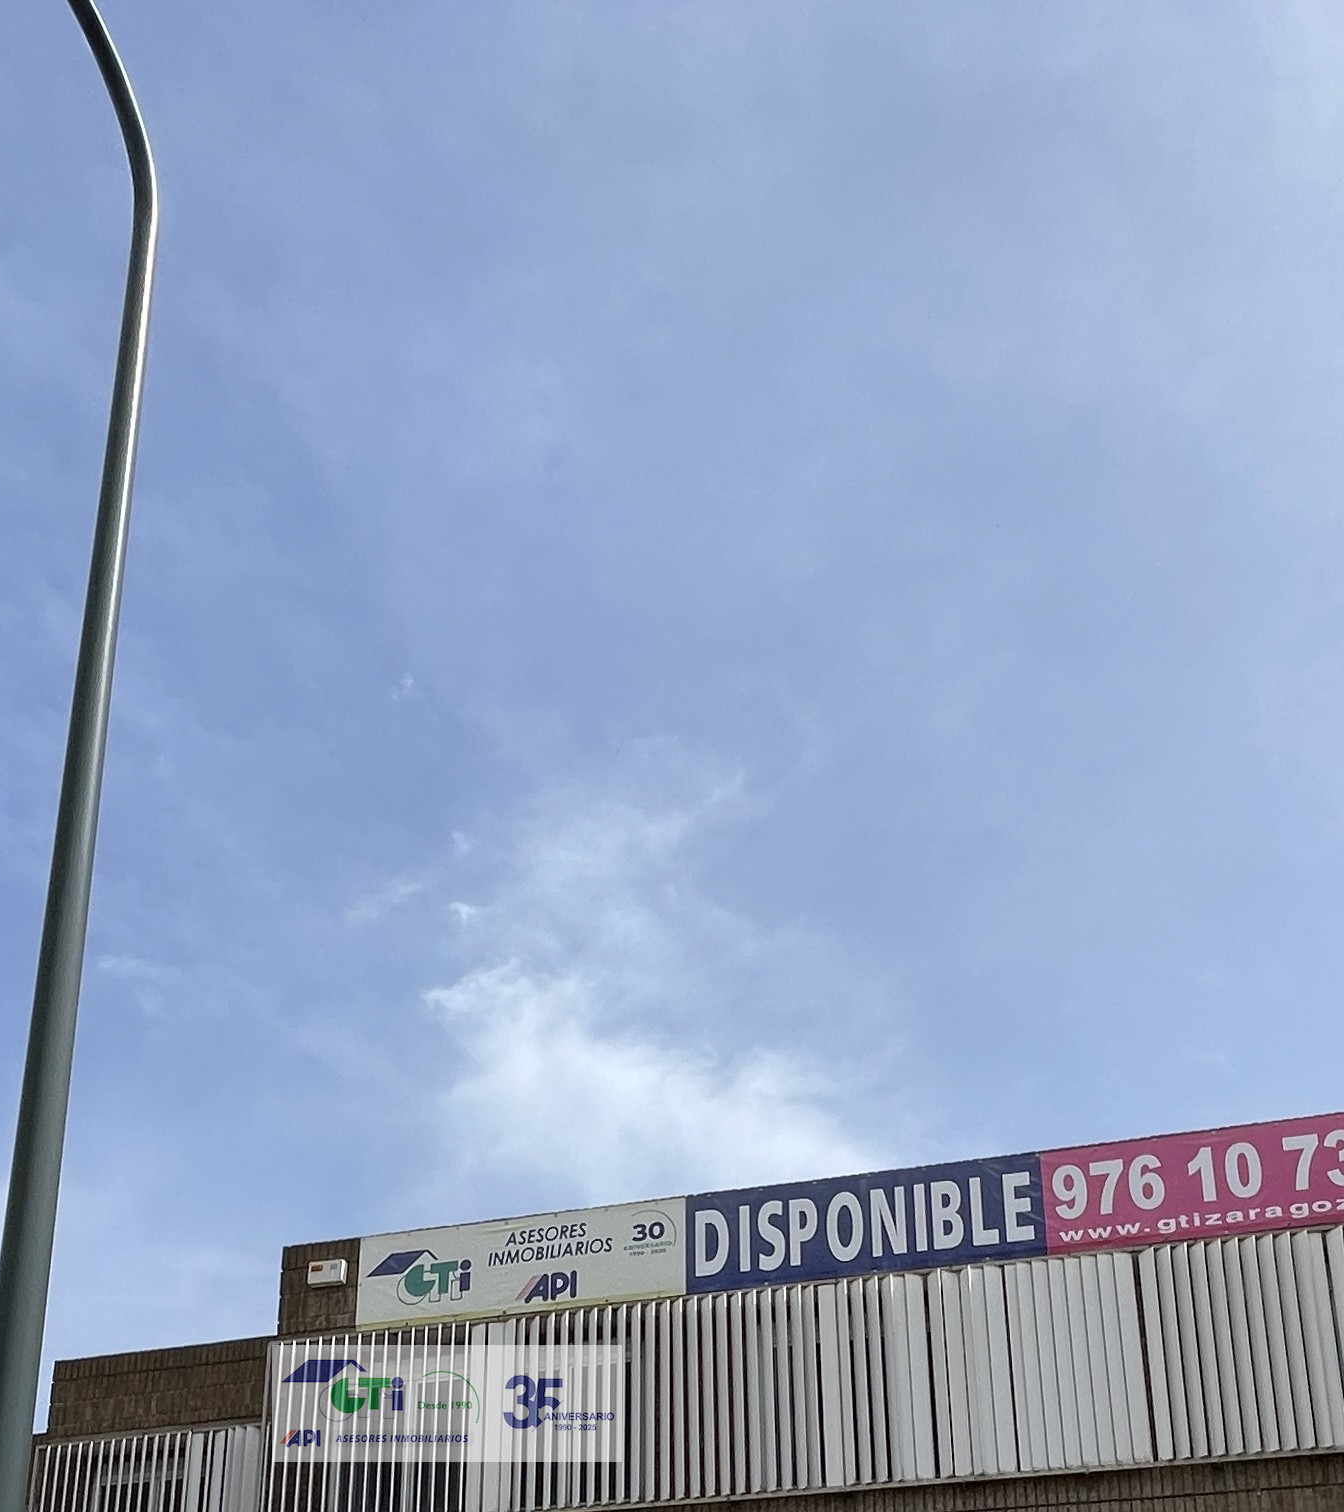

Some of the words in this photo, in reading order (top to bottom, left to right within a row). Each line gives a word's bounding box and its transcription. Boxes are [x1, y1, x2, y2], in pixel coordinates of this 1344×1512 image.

[1051, 1154, 1166, 1220] 976
[1187, 1142, 1263, 1201] 10
[505, 1222, 587, 1247] ASESORES
[632, 1221, 665, 1242] 30
[694, 1170, 1036, 1279] DISPONIBLE
[487, 1237, 613, 1267] INMOBILIARIOS
[520, 1270, 577, 1304] API
